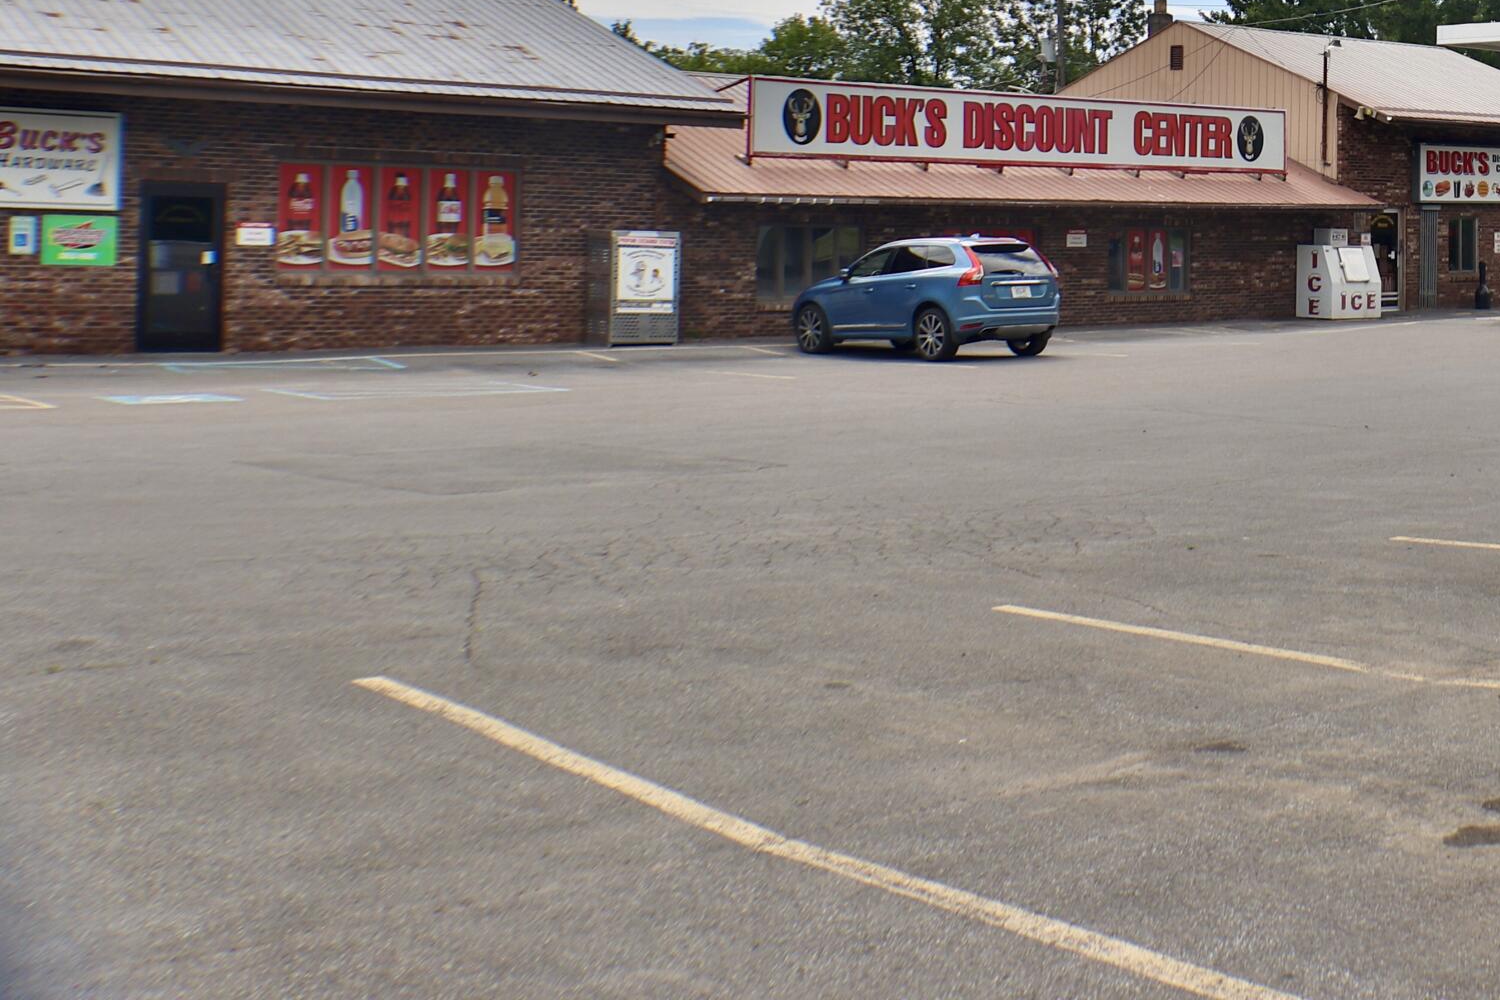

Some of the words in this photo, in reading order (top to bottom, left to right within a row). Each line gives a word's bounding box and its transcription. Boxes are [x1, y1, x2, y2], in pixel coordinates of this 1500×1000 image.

[0, 121, 105, 153] BUCK'S
[826, 93, 947, 147] BUCK'S
[963, 101, 1113, 154] DISCOUNT
[1134, 110, 1233, 159] CENTER
[1426, 150, 1490, 176] BUCK'S
[1307, 250, 1322, 316] ICE
[1340, 291, 1377, 311] ICE
